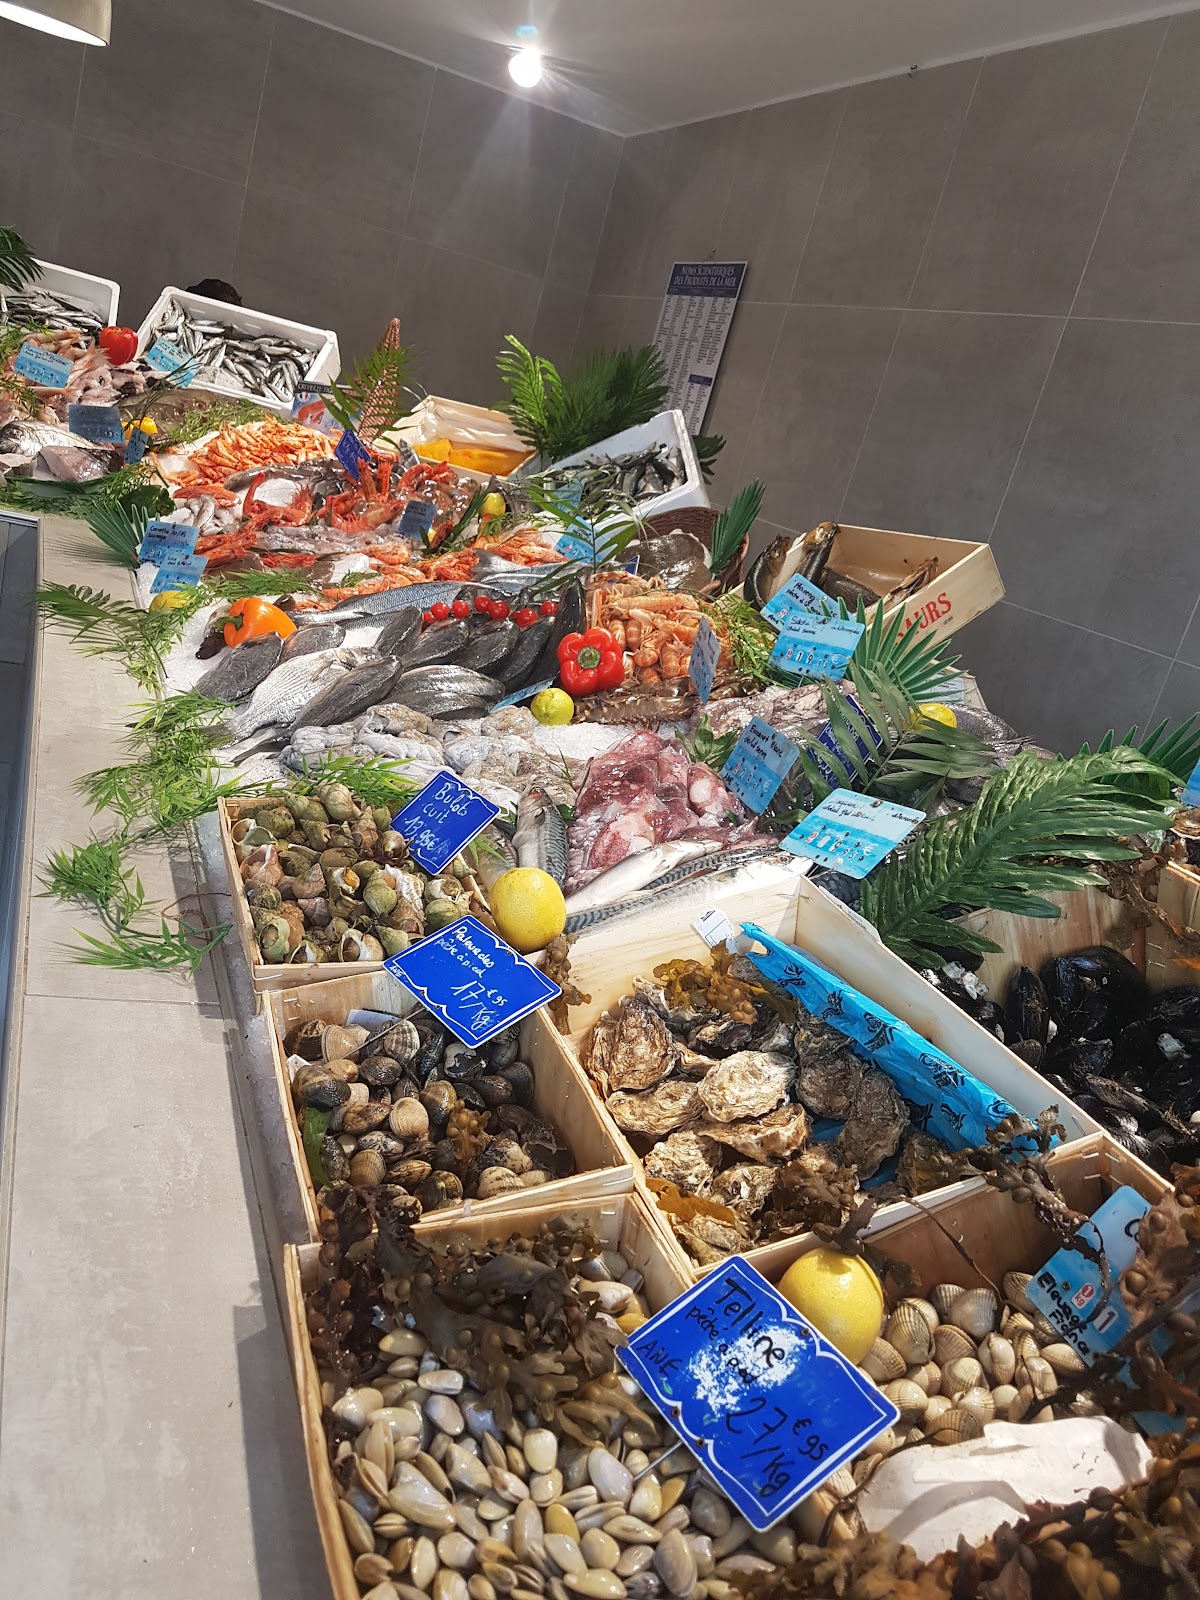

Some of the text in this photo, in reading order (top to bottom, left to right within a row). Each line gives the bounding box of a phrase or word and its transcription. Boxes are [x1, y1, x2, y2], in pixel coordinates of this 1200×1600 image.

[423, 803, 451, 824] cuit
[434, 782, 470, 816] Bulots
[451, 926, 495, 969] Palourdes
[715, 1277, 786, 1369] Telline
[726, 1396, 789, 1445] 27
